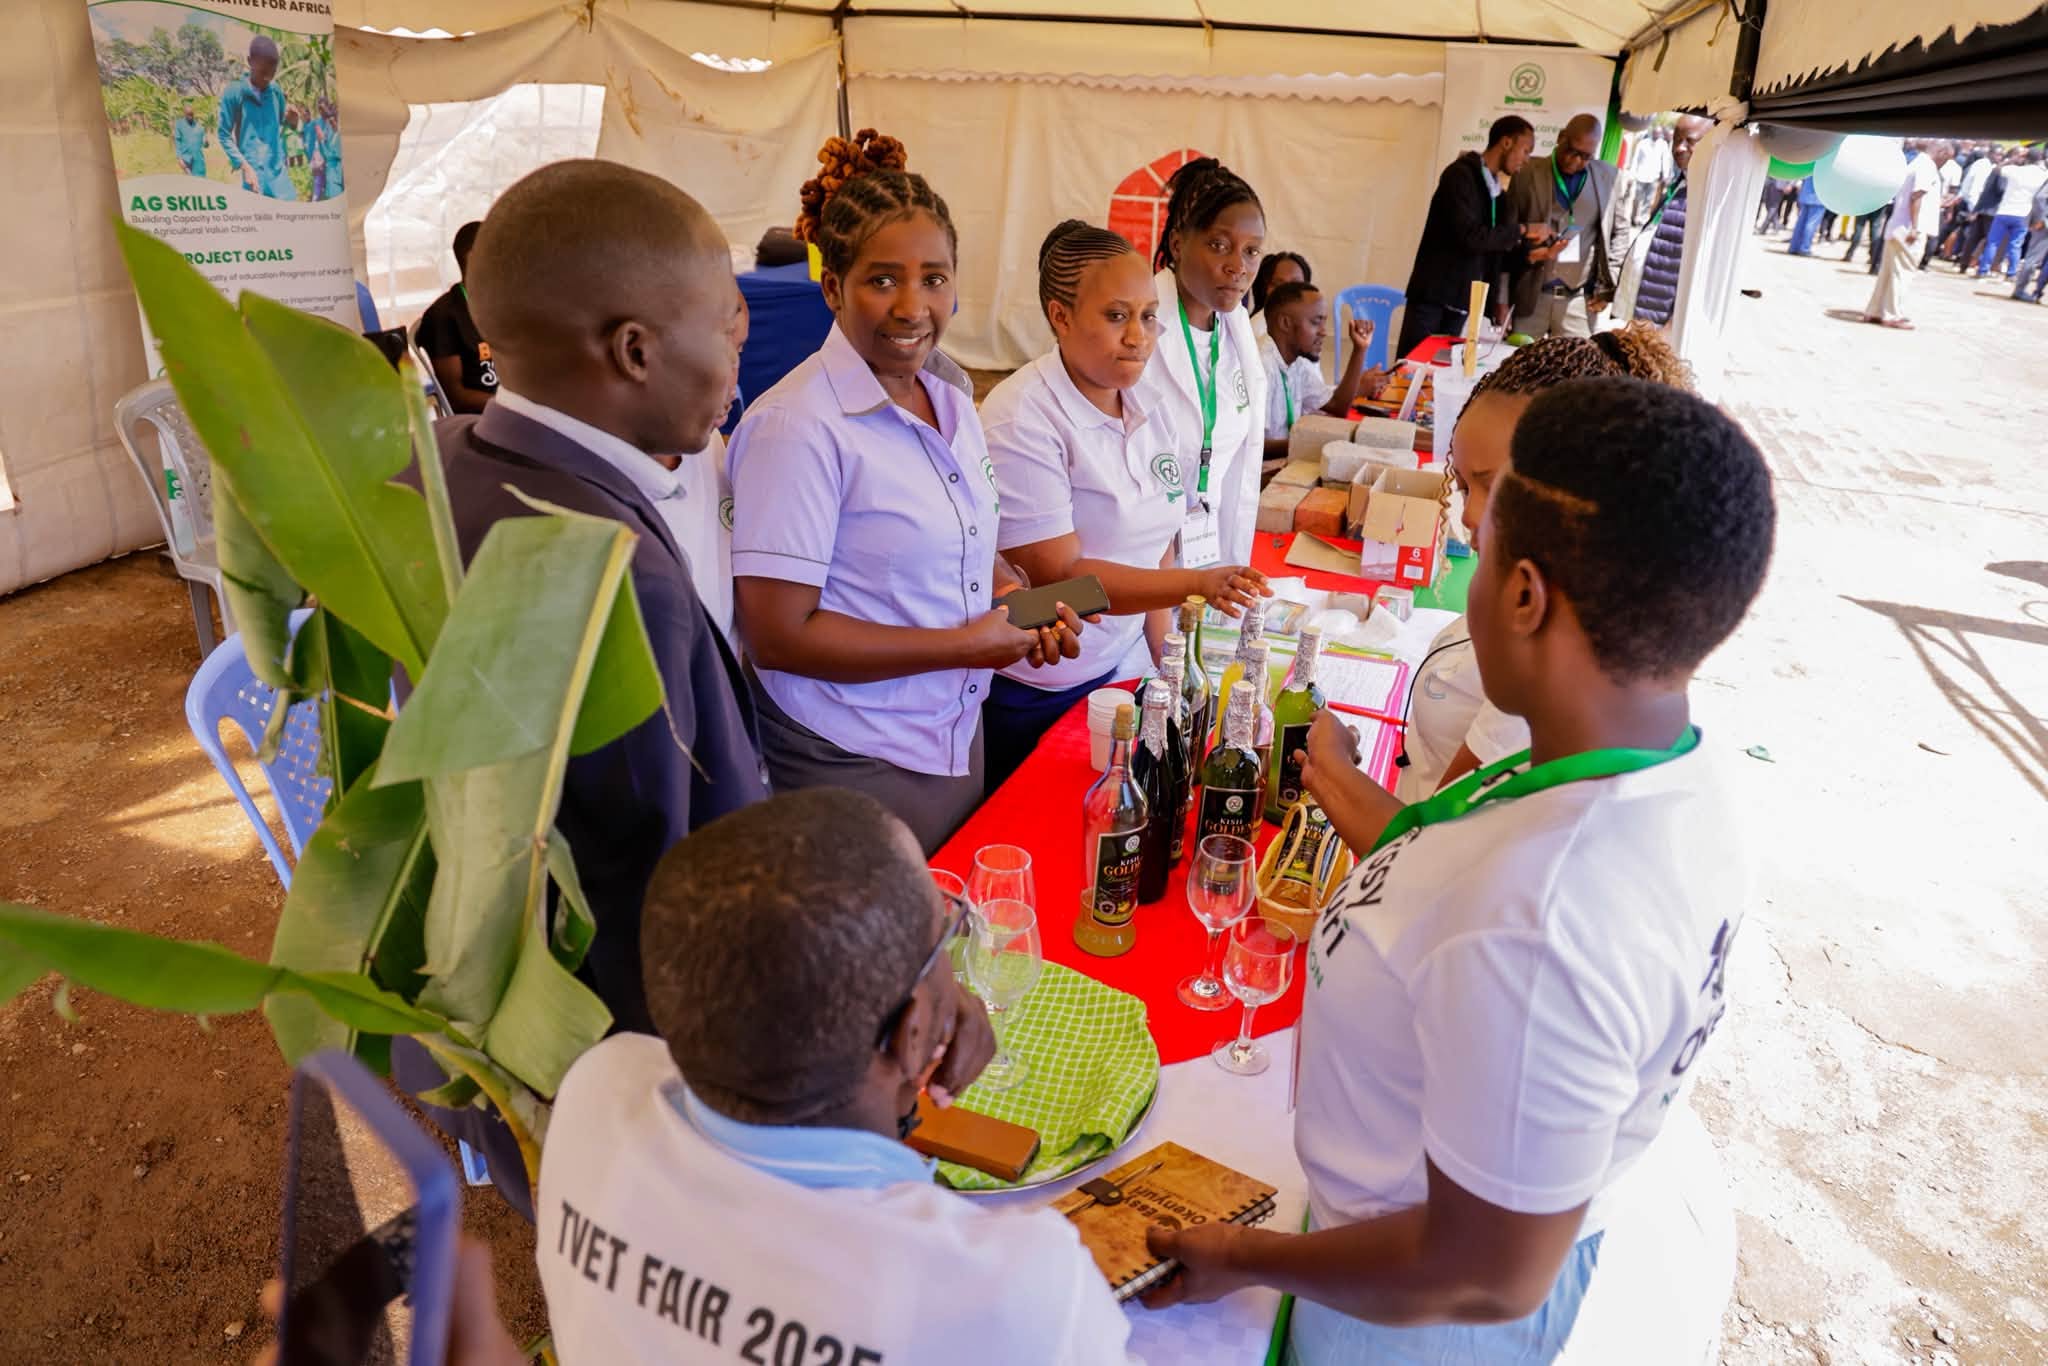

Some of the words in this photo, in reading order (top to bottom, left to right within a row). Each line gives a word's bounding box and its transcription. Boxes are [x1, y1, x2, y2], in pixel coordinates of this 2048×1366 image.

[261, 0, 287, 11] FOR
[289, 3, 332, 15] AFRICA
[130, 195, 163, 211] AG
[166, 195, 228, 211] SKILLS
[131, 215, 172, 225] Building
[173, 215, 210, 224] Capacity
[223, 214, 252, 222] Deliver
[254, 213, 273, 221] Skills
[275, 213, 329, 222] Programmes
[153, 227, 203, 237] Agricultural
[230, 225, 259, 233] Chain.
[183, 251, 241, 265] ROJECT
[245, 249, 294, 262] GOALS
[207, 274, 228, 284] uality
[239, 271, 279, 281] education
[560, 1200, 629, 1293] TVET
[637, 1253, 731, 1346] FAIR
